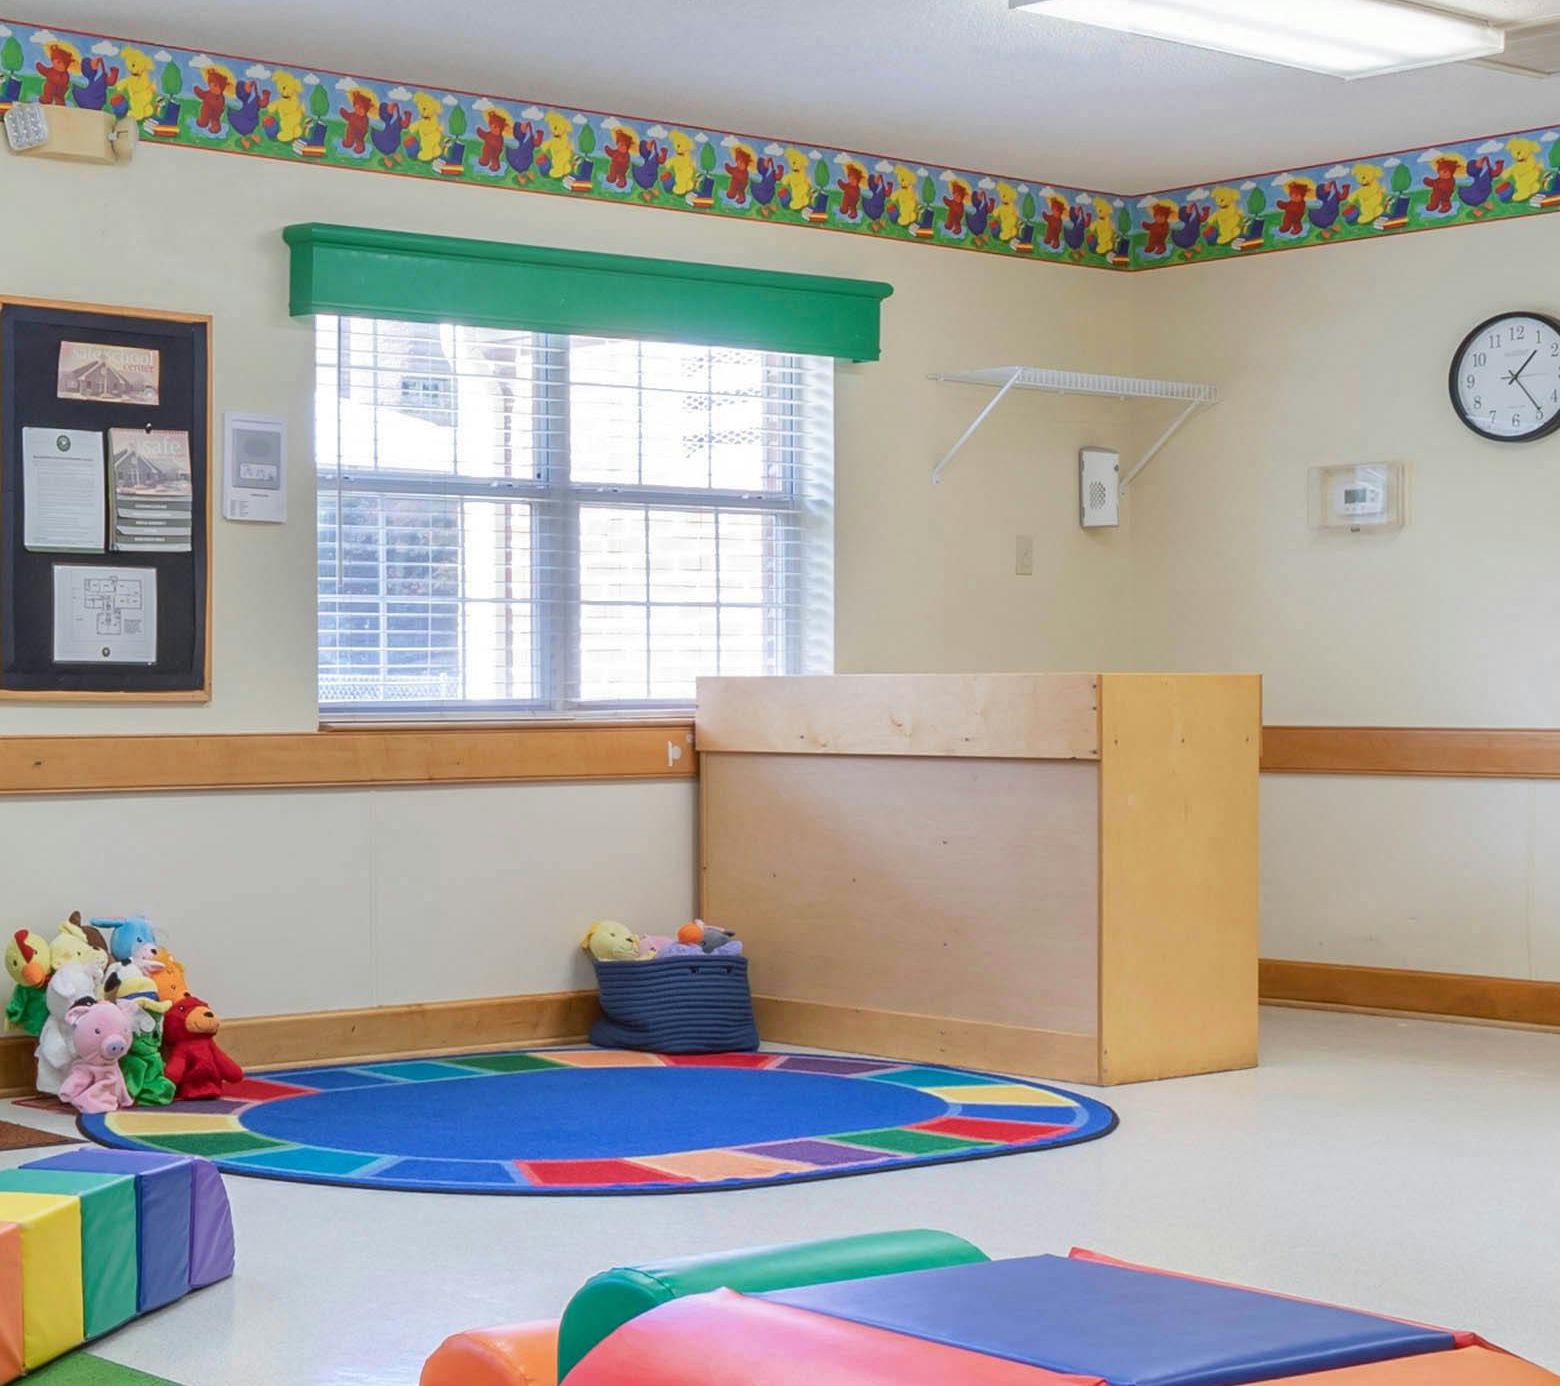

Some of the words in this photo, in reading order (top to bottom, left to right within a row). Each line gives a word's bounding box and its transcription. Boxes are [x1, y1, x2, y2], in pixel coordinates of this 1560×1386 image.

[1509, 325, 1525, 341] 12
[1536, 329, 1541, 344] 1
[1489, 334, 1501, 349] 11
[1550, 342, 1559, 357] 2
[1473, 352, 1487, 368] 10
[1466, 374, 1475, 389] 9
[1472, 395, 1482, 409] 8
[1550, 388, 1558, 403] 4
[1489, 410, 1497, 424] 7
[1511, 413, 1520, 427] 6
